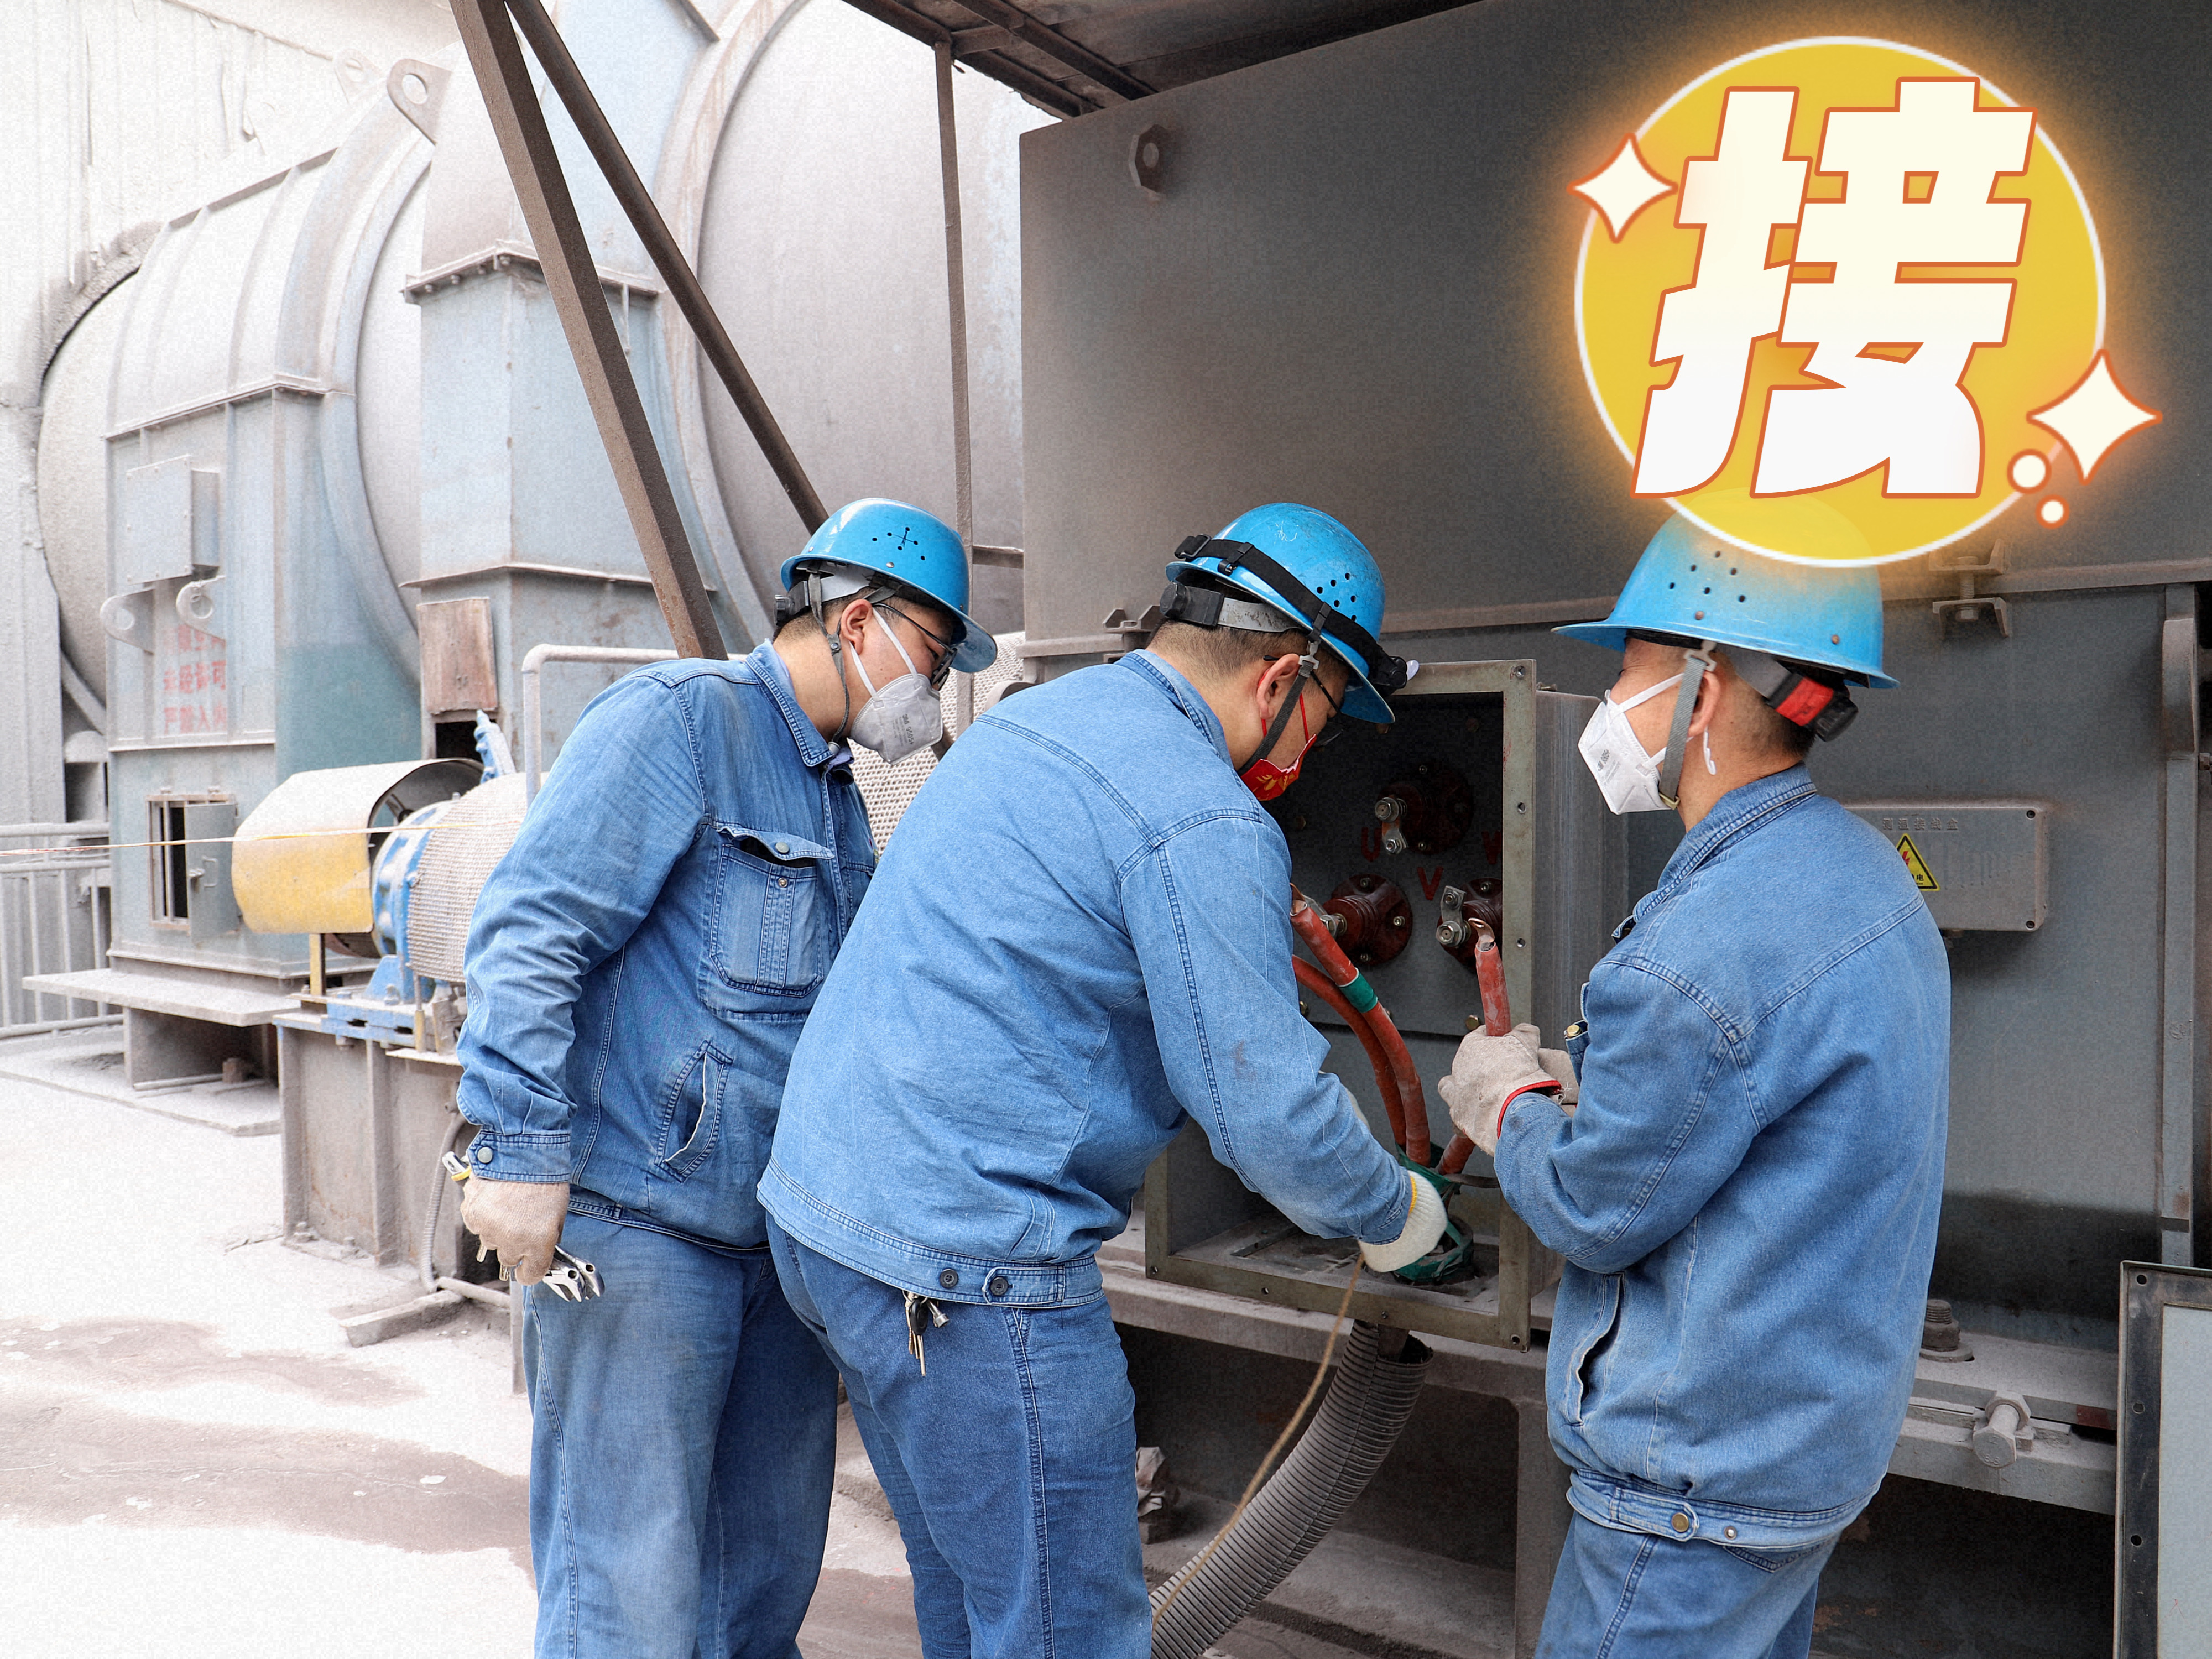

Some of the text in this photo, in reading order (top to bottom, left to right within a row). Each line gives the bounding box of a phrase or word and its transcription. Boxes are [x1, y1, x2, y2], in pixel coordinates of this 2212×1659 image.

[1882, 817, 1958, 830] 测温接线盒
[1361, 828, 1382, 862] U
[1417, 866, 1443, 900] V
